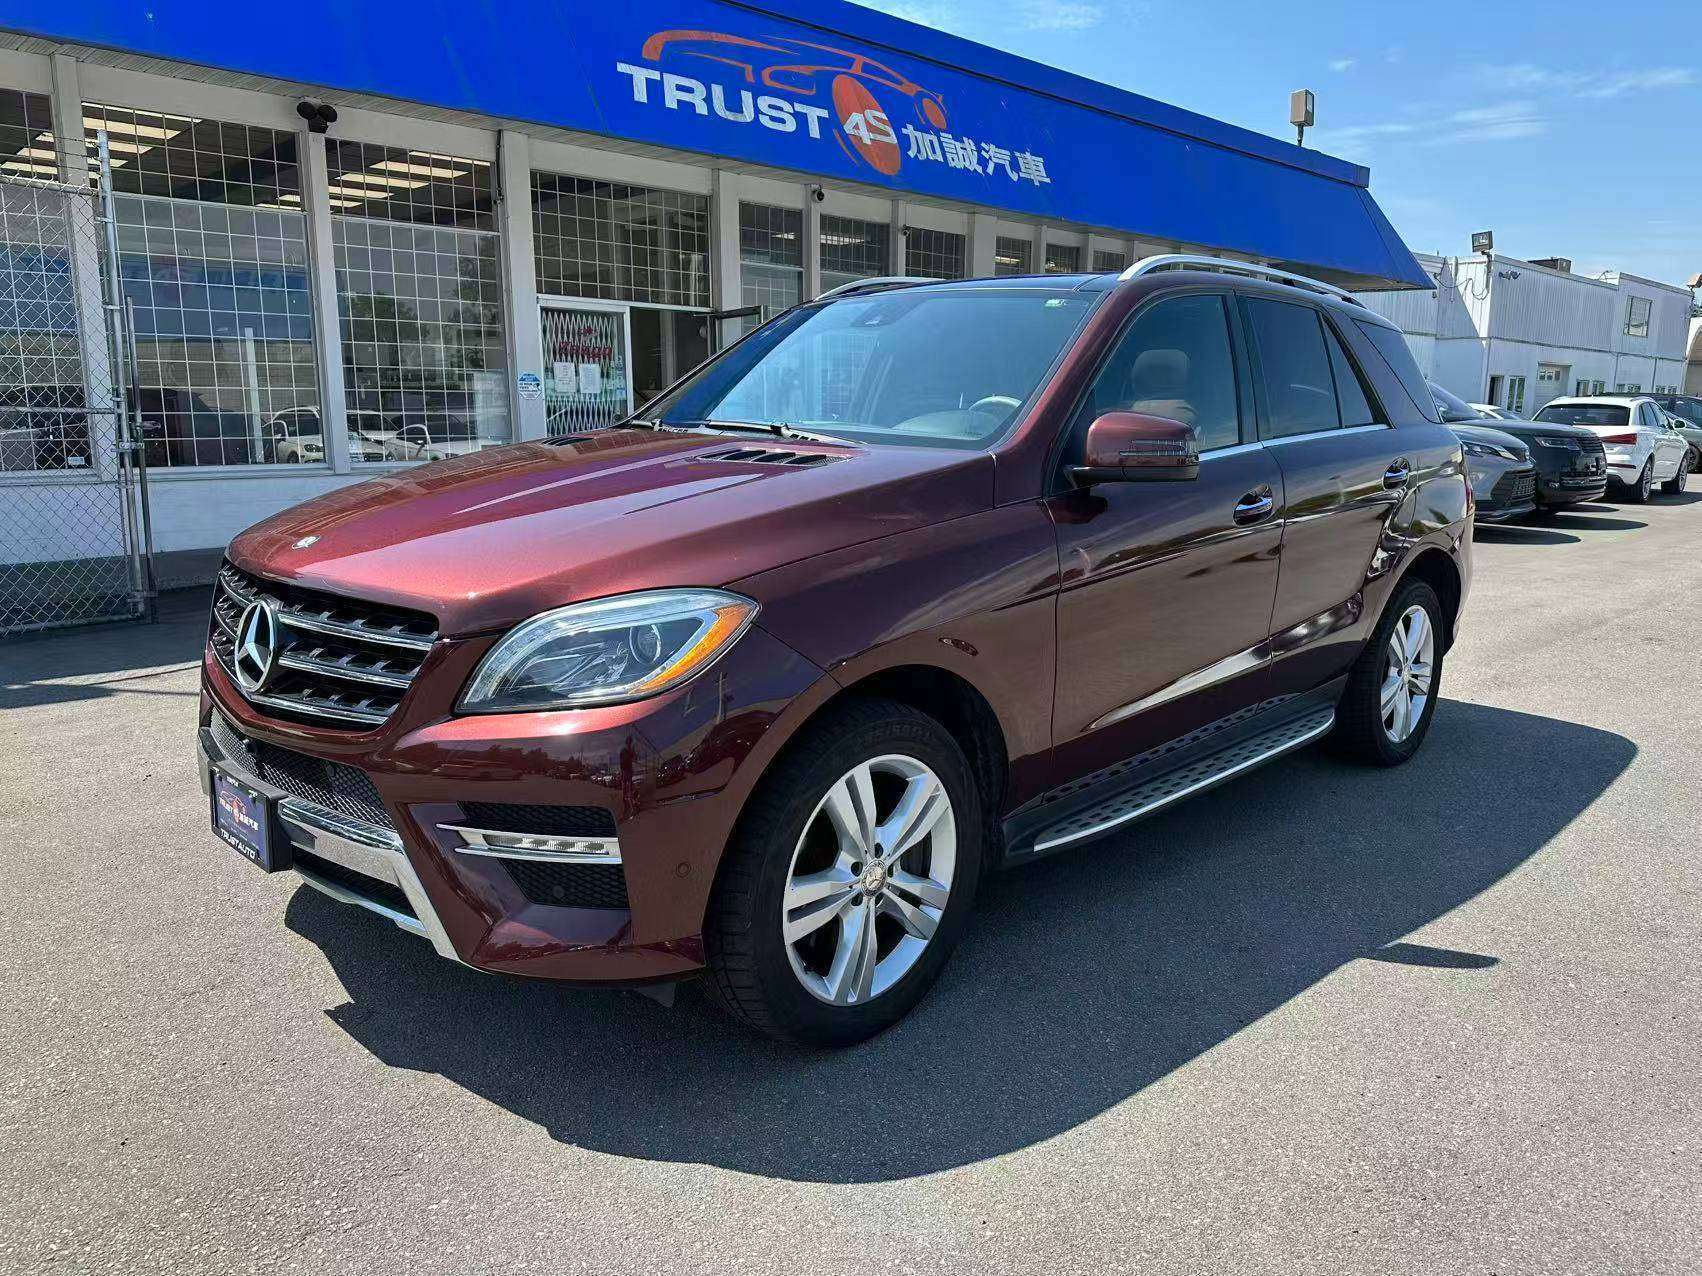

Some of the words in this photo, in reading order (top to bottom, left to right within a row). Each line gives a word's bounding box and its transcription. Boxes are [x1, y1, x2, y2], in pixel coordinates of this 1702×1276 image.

[616, 61, 829, 139] TRUST
[844, 109, 898, 145] 4S
[902, 123, 1051, 186] 加誠汽車
